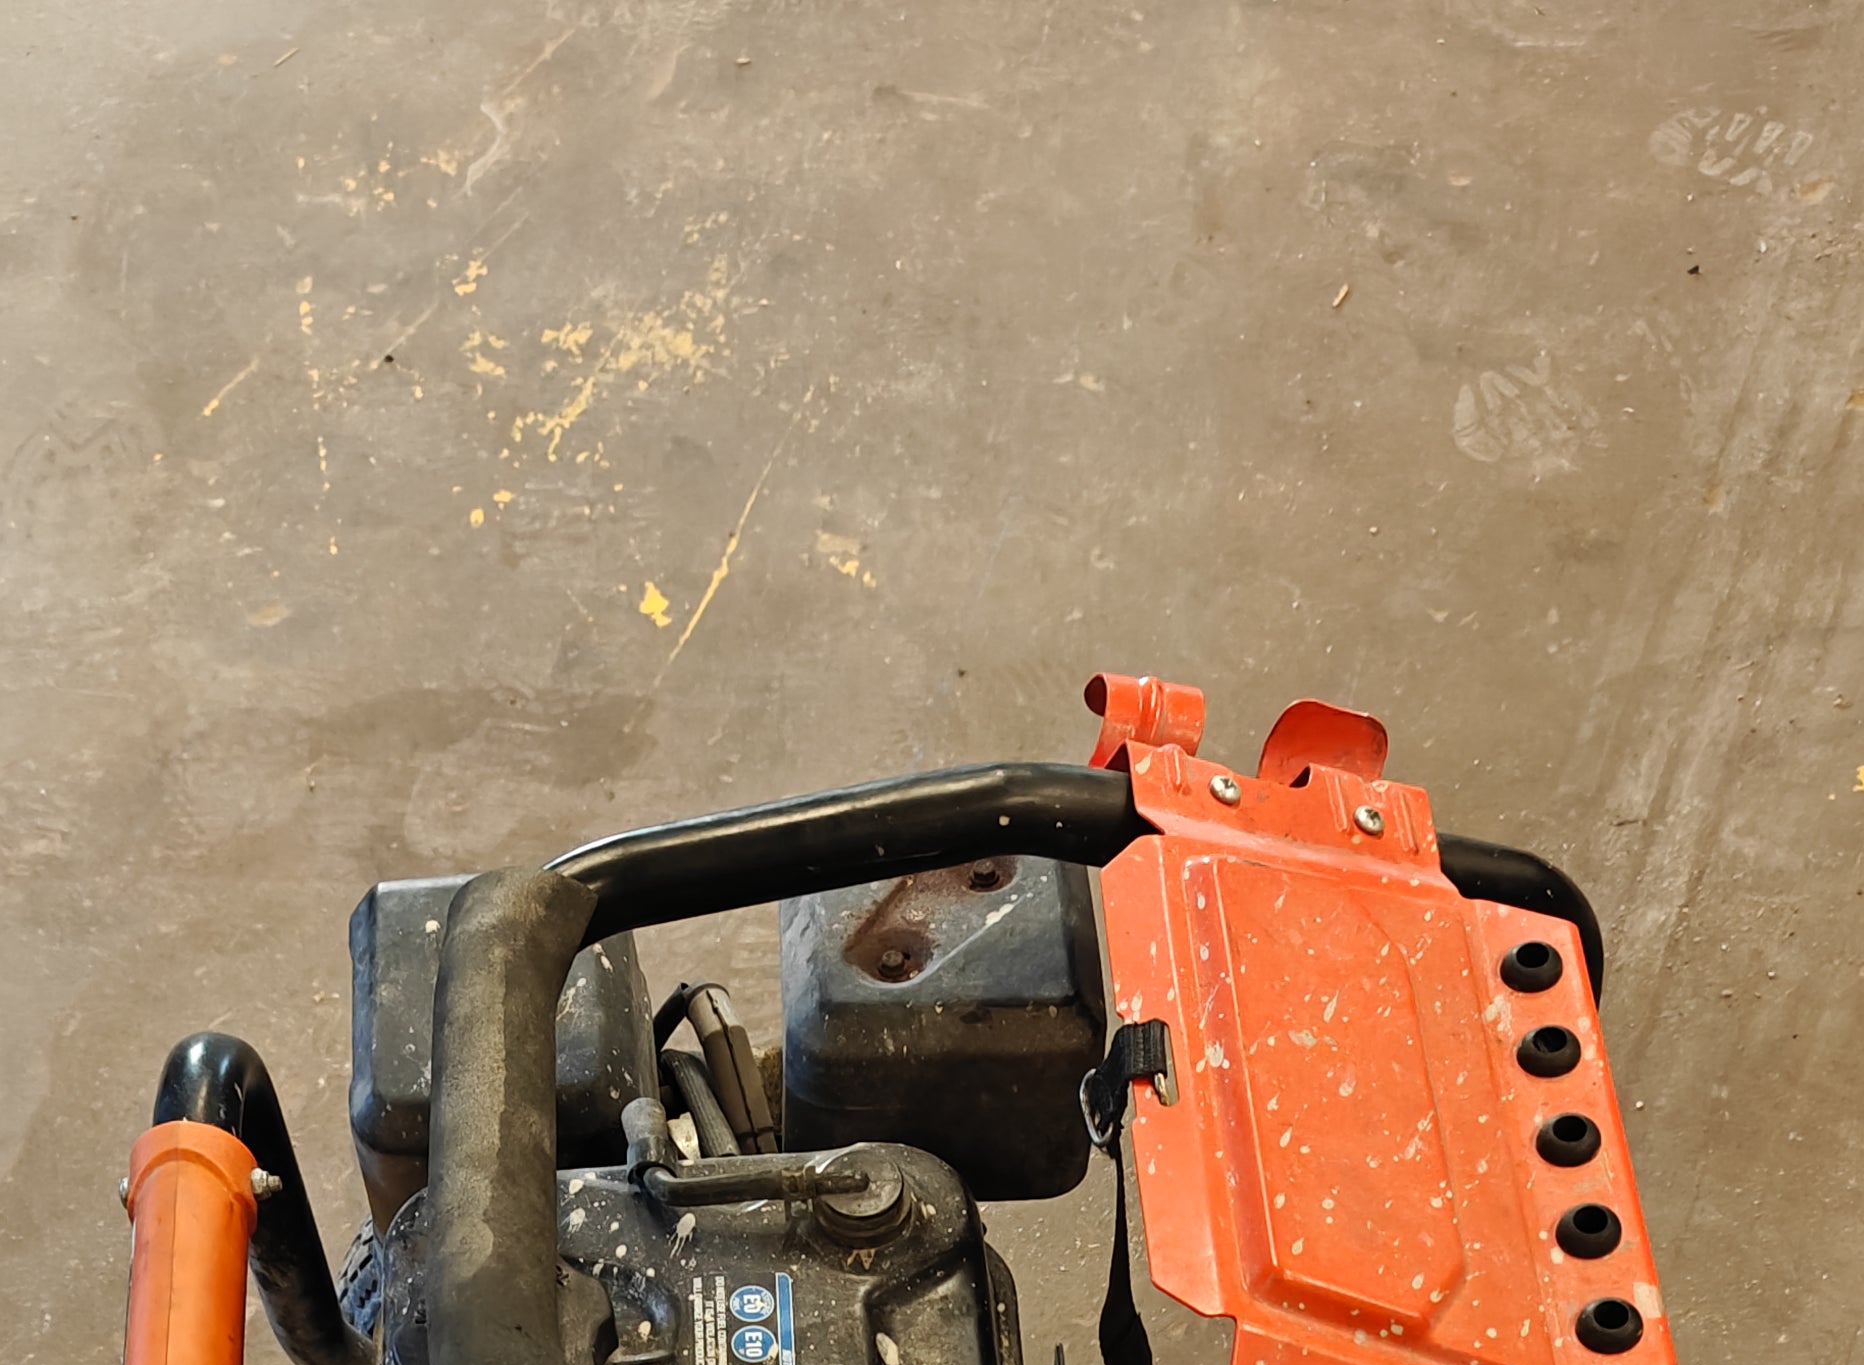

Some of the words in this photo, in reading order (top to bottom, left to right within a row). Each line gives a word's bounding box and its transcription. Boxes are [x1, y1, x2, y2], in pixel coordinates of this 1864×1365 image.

[743, 1294, 761, 1314] E0
[717, 1313, 726, 1329] FUEL
[745, 1331, 763, 1357] E10
